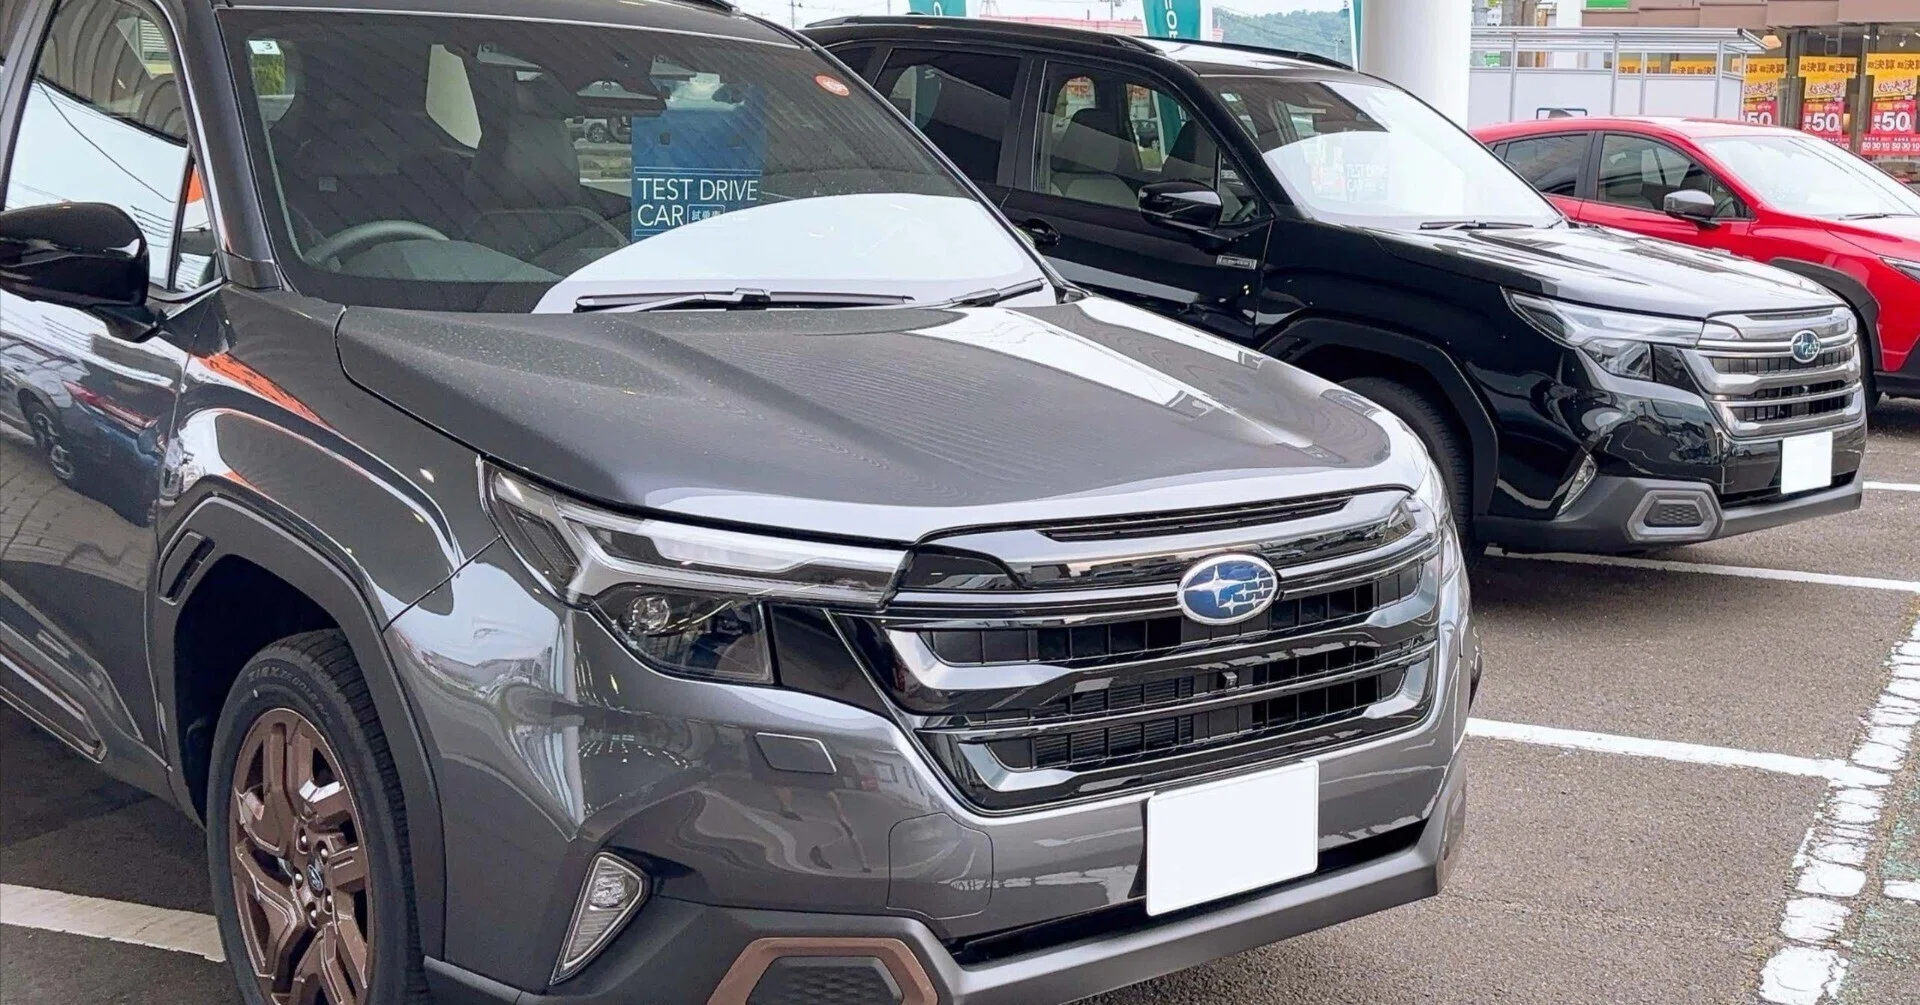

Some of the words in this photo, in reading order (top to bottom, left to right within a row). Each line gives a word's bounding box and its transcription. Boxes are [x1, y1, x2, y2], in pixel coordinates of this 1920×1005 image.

[262, 41, 273, 50] 3
[1812, 112, 1839, 132] 50
[1881, 111, 1911, 132] 50
[637, 178, 694, 200] TEST
[700, 179, 759, 201] DRIVE
[637, 204, 684, 227] CAR
